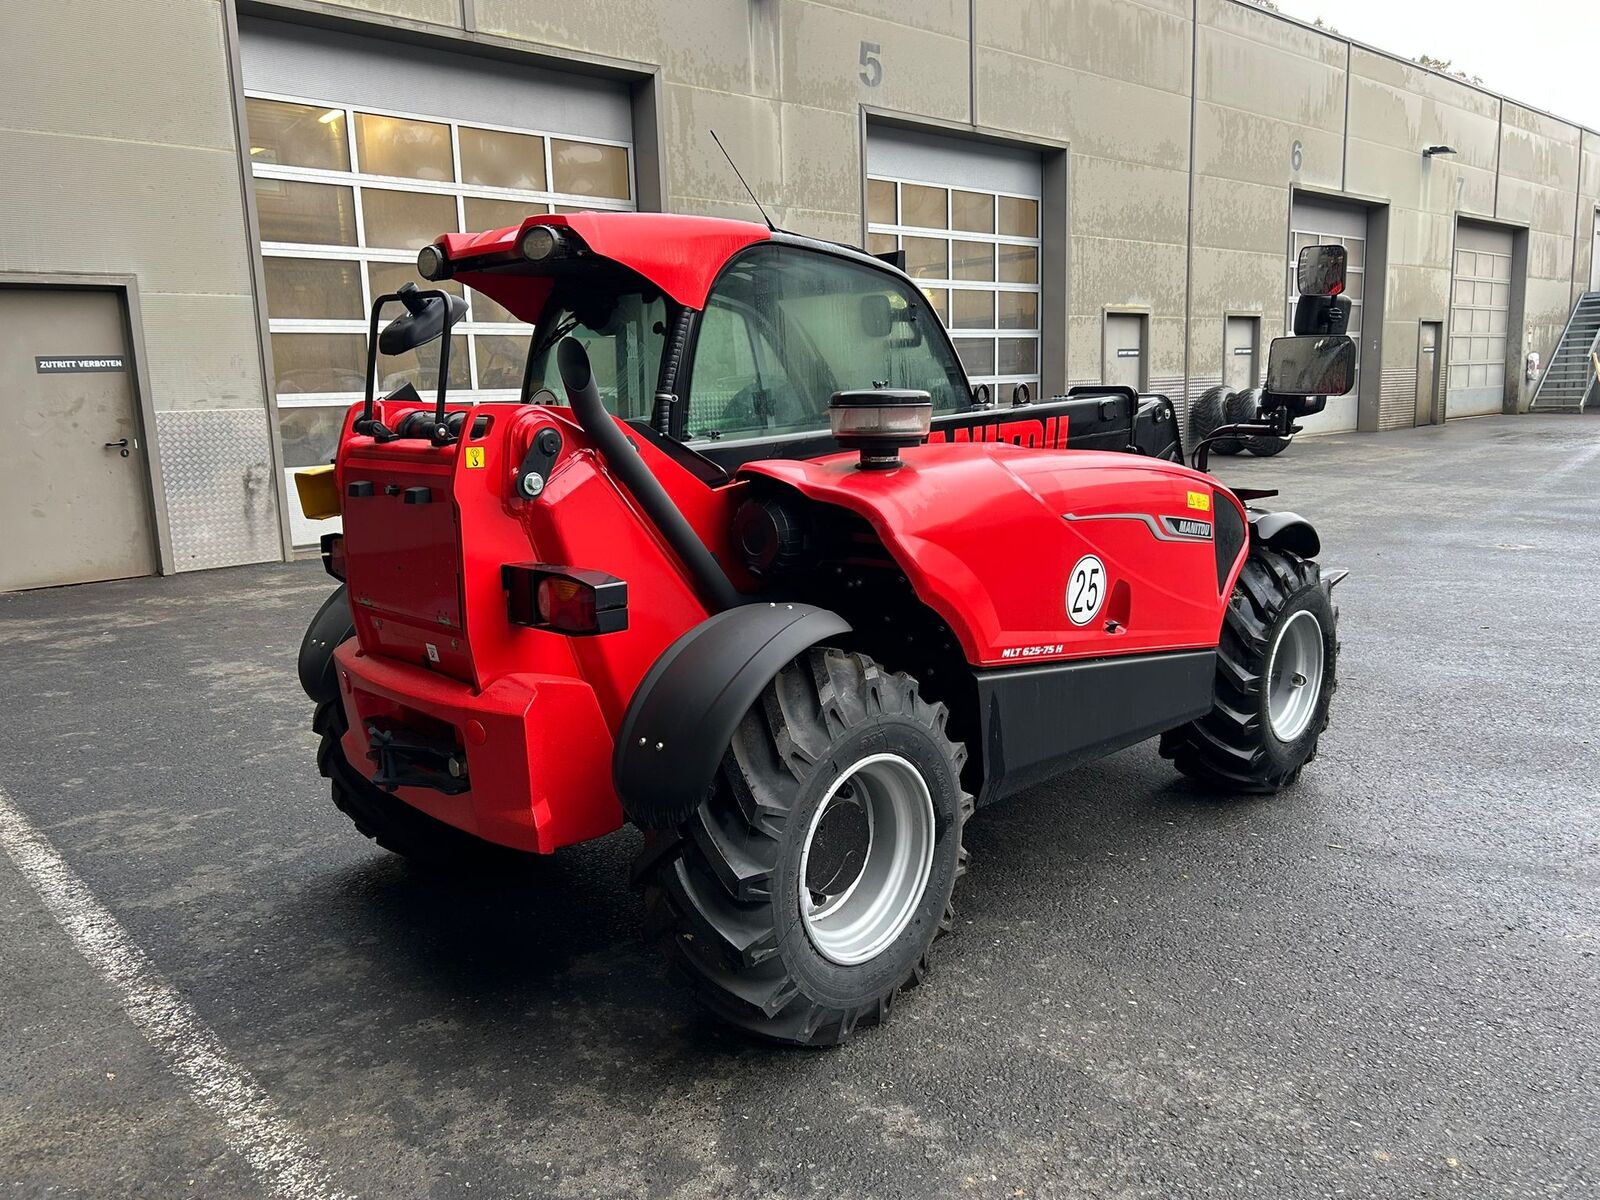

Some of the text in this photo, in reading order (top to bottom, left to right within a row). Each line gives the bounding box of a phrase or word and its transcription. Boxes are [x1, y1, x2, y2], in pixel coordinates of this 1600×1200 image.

[859, 40, 882, 87] 5
[1291, 140, 1302, 171] 6
[1456, 176, 1465, 207] 7
[40, 359, 122, 369] ZUTRITT VERBOTEN
[1178, 520, 1210, 536] MANITOU
[1072, 568, 1099, 613] 25
[1001, 644, 1064, 658] MLT 625-75 H
